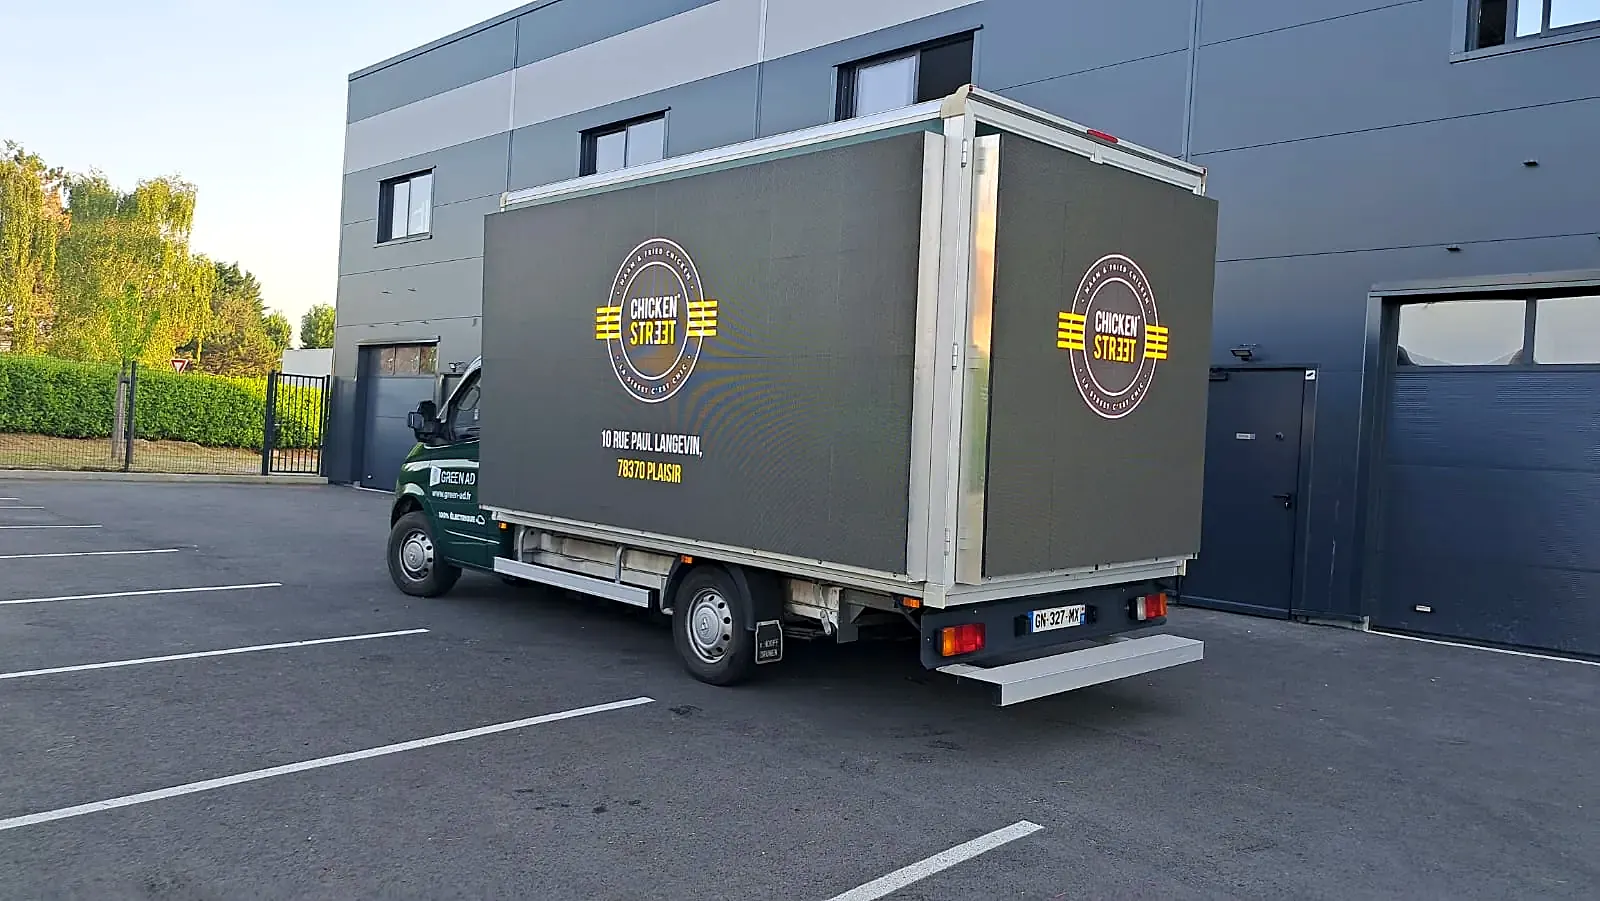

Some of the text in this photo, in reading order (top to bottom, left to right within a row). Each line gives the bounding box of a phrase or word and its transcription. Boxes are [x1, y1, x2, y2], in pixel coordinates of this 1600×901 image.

[644, 247, 663, 258] FRIED
[666, 250, 692, 281] CHICKEN
[1129, 270, 1150, 305] CHICKEN
[630, 295, 678, 320] CHICKEN
[630, 319, 677, 345] STREET
[1095, 310, 1138, 337] CHICKEN
[1094, 335, 1137, 363] STREET
[672, 363, 688, 384] CHIC
[601, 429, 703, 458] 10 RUE PAUL LANGEVIN,
[441, 470, 476, 486] GREEN AD
[617, 458, 682, 484] 78370 PLAISIR
[431, 490, 472, 500] www.green-ad.fr
[438, 511, 449, 519] 100%
